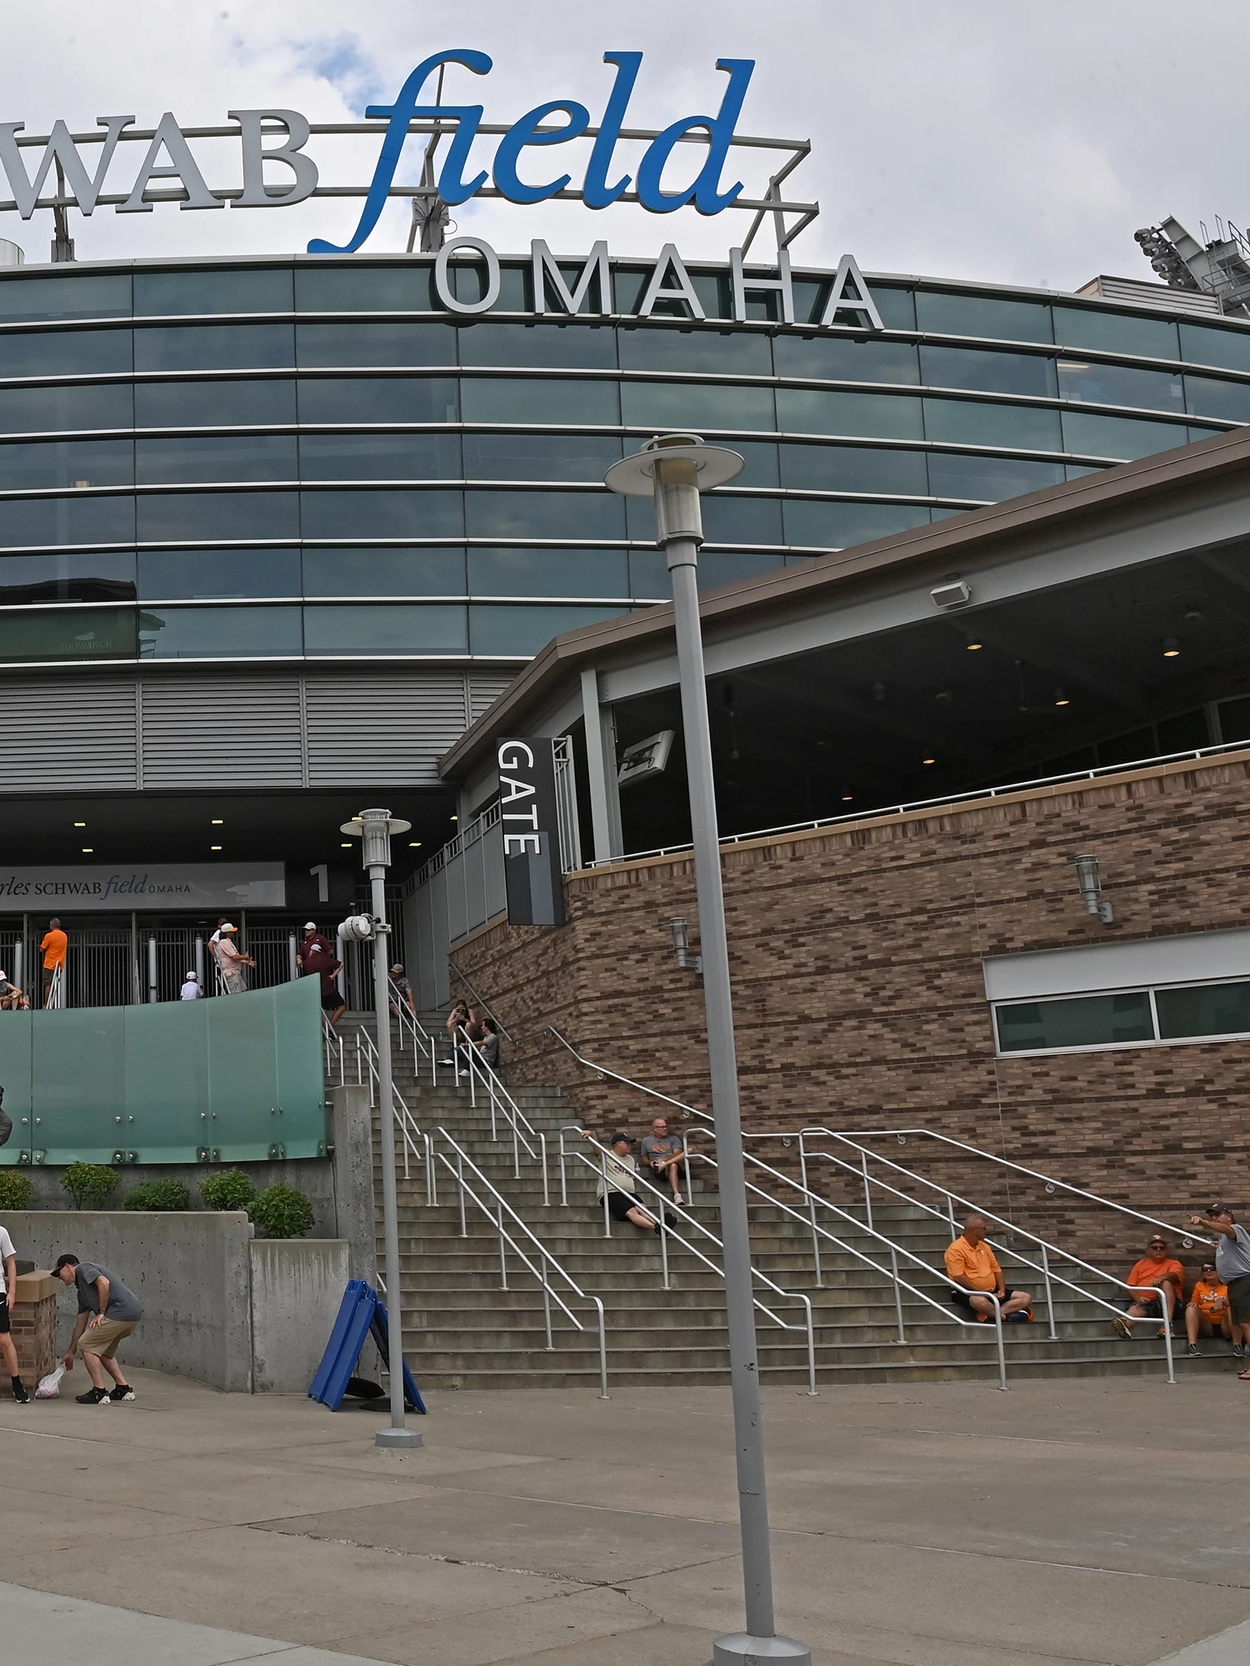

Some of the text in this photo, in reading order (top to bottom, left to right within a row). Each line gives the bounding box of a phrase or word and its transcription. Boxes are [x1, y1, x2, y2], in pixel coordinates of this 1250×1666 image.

[307, 48, 756, 253] field
[434, 236, 885, 332] OMAHA
[498, 740, 540, 855] GATE
[34, 881, 102, 896] SCHWAB
[100, 874, 148, 900] field
[148, 884, 191, 894] OMAHA
[309, 864, 329, 902] 1
